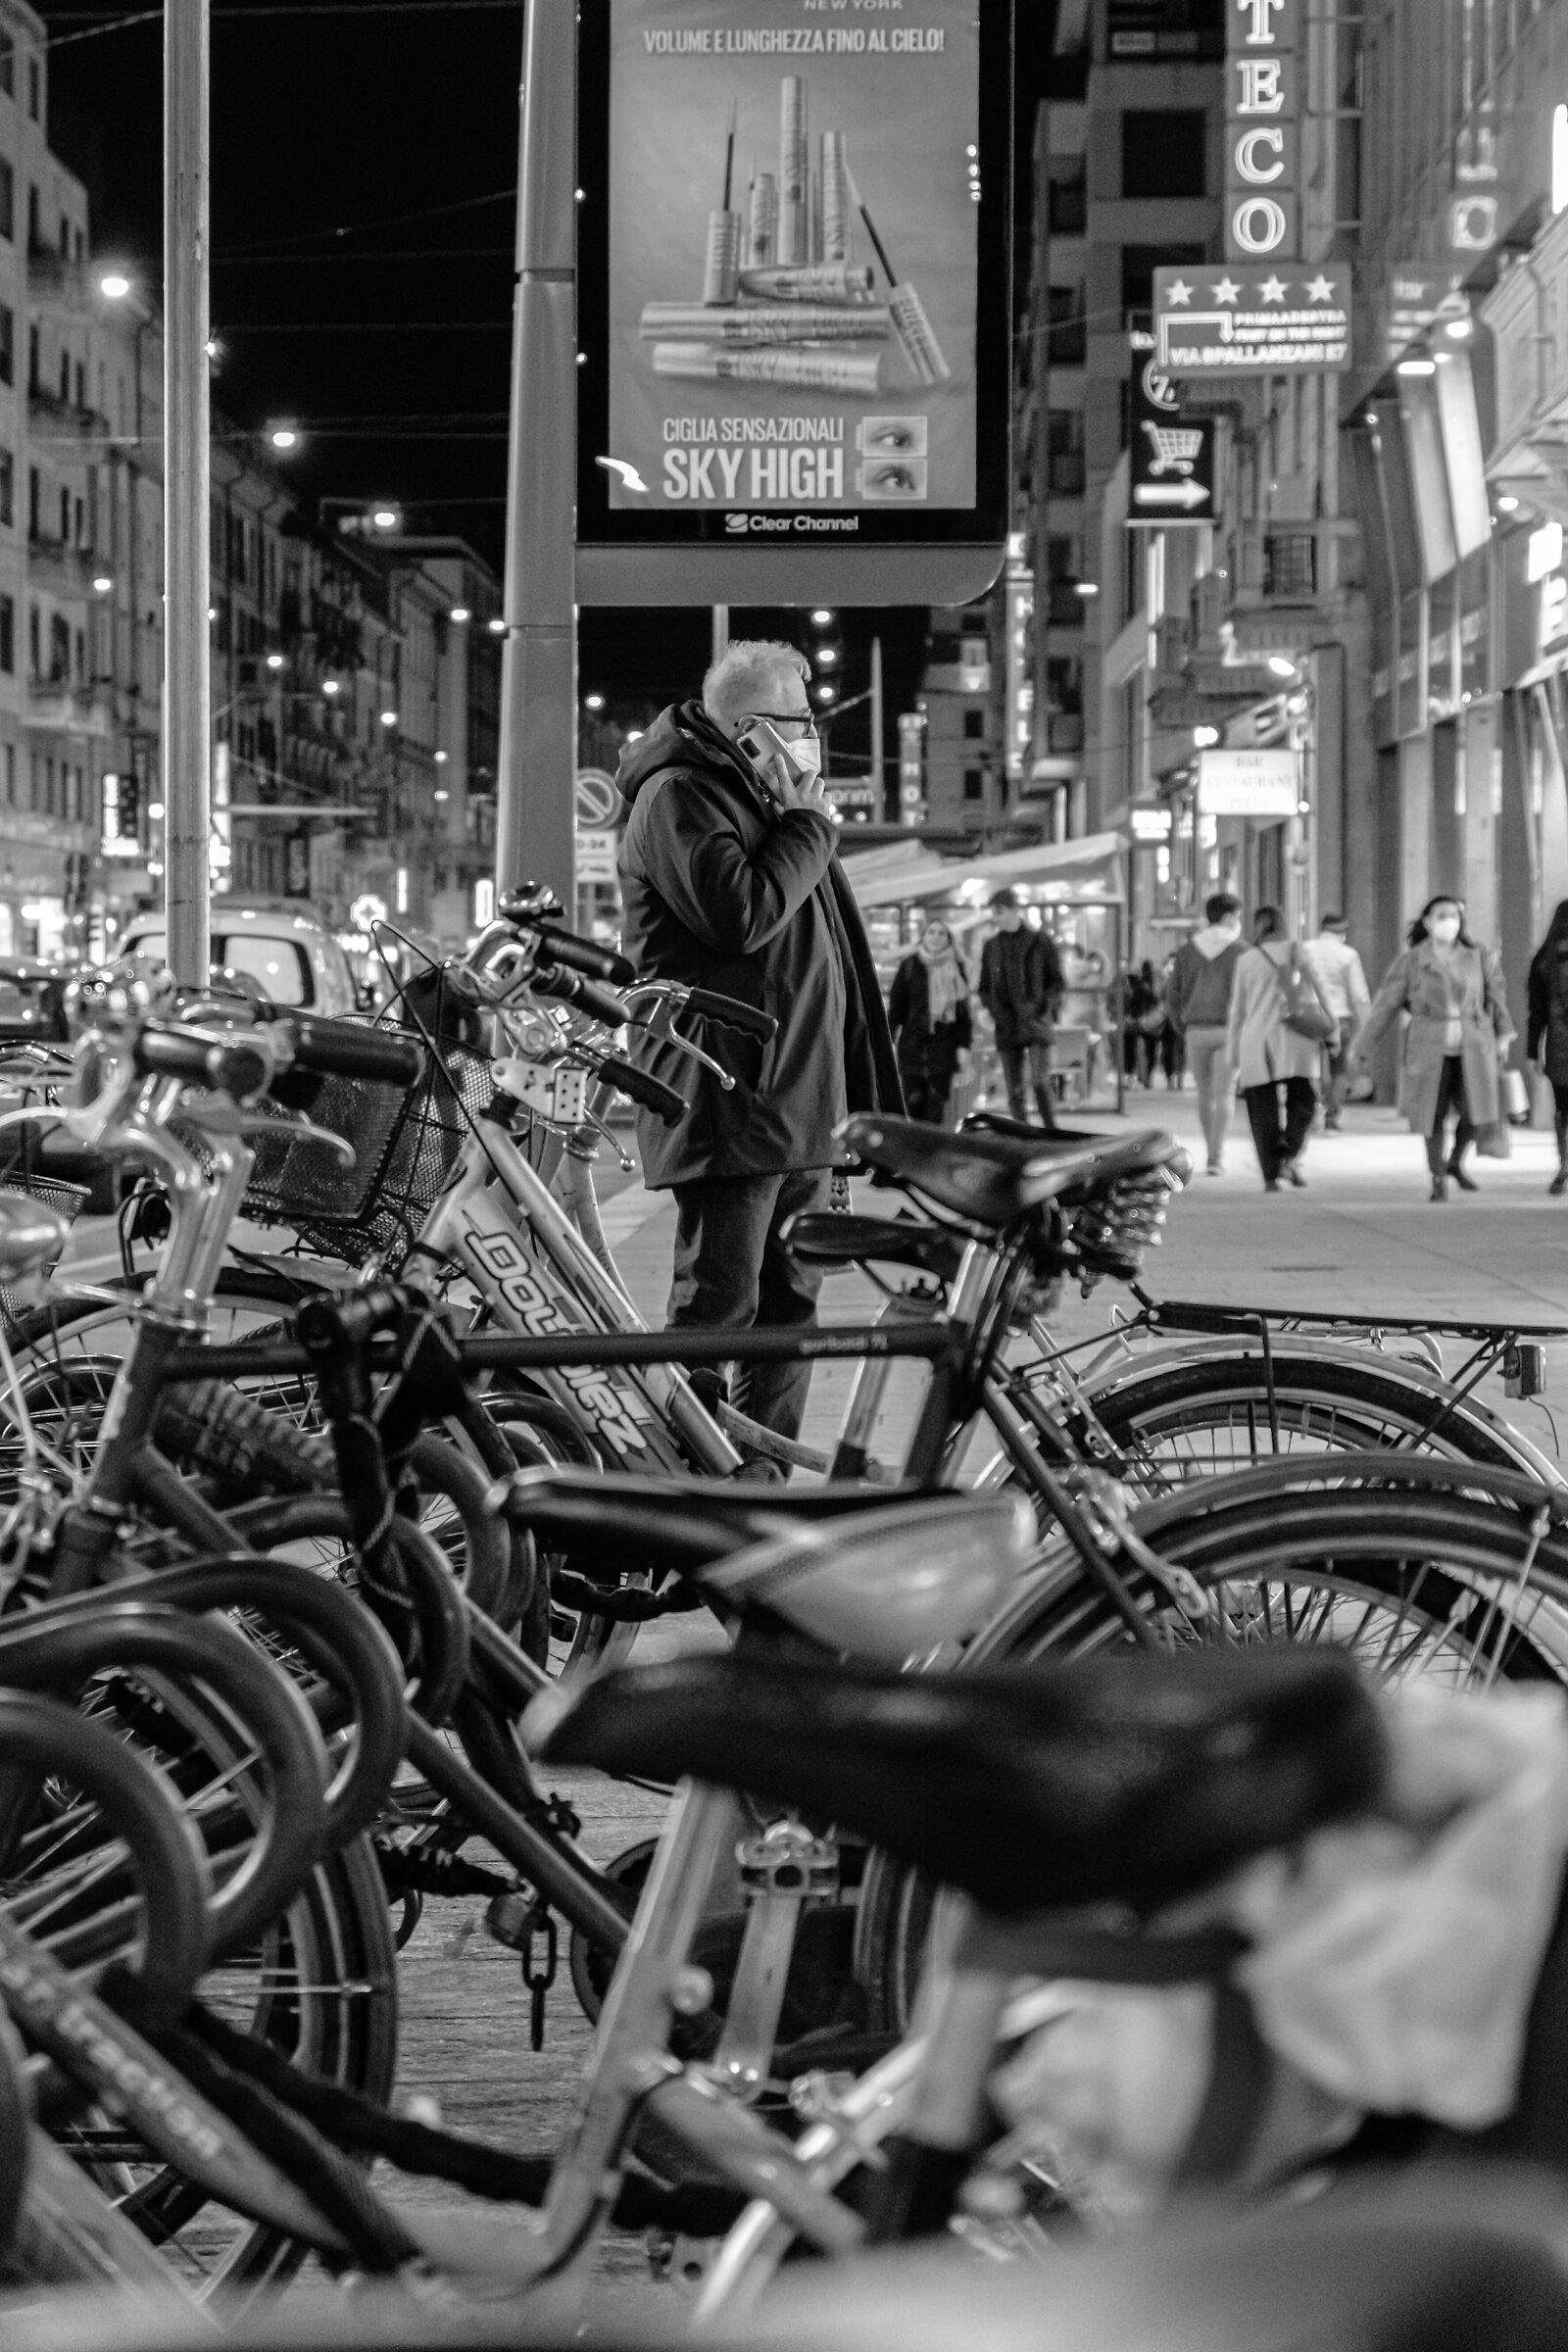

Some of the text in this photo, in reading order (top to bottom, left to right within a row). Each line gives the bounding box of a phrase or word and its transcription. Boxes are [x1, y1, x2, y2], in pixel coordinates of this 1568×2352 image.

[804, 0, 903, 11] NEW YORK
[644, 27, 944, 54] VOLUME E LUNGHEZZA FINO AL CIELO!
[1232, 0, 1286, 253] TECO
[663, 416, 844, 442] CIGLIA SENSAZIONALI
[663, 448, 744, 499] SKY
[750, 448, 843, 499] HIGH
[750, 515, 858, 530] Clear Channel
